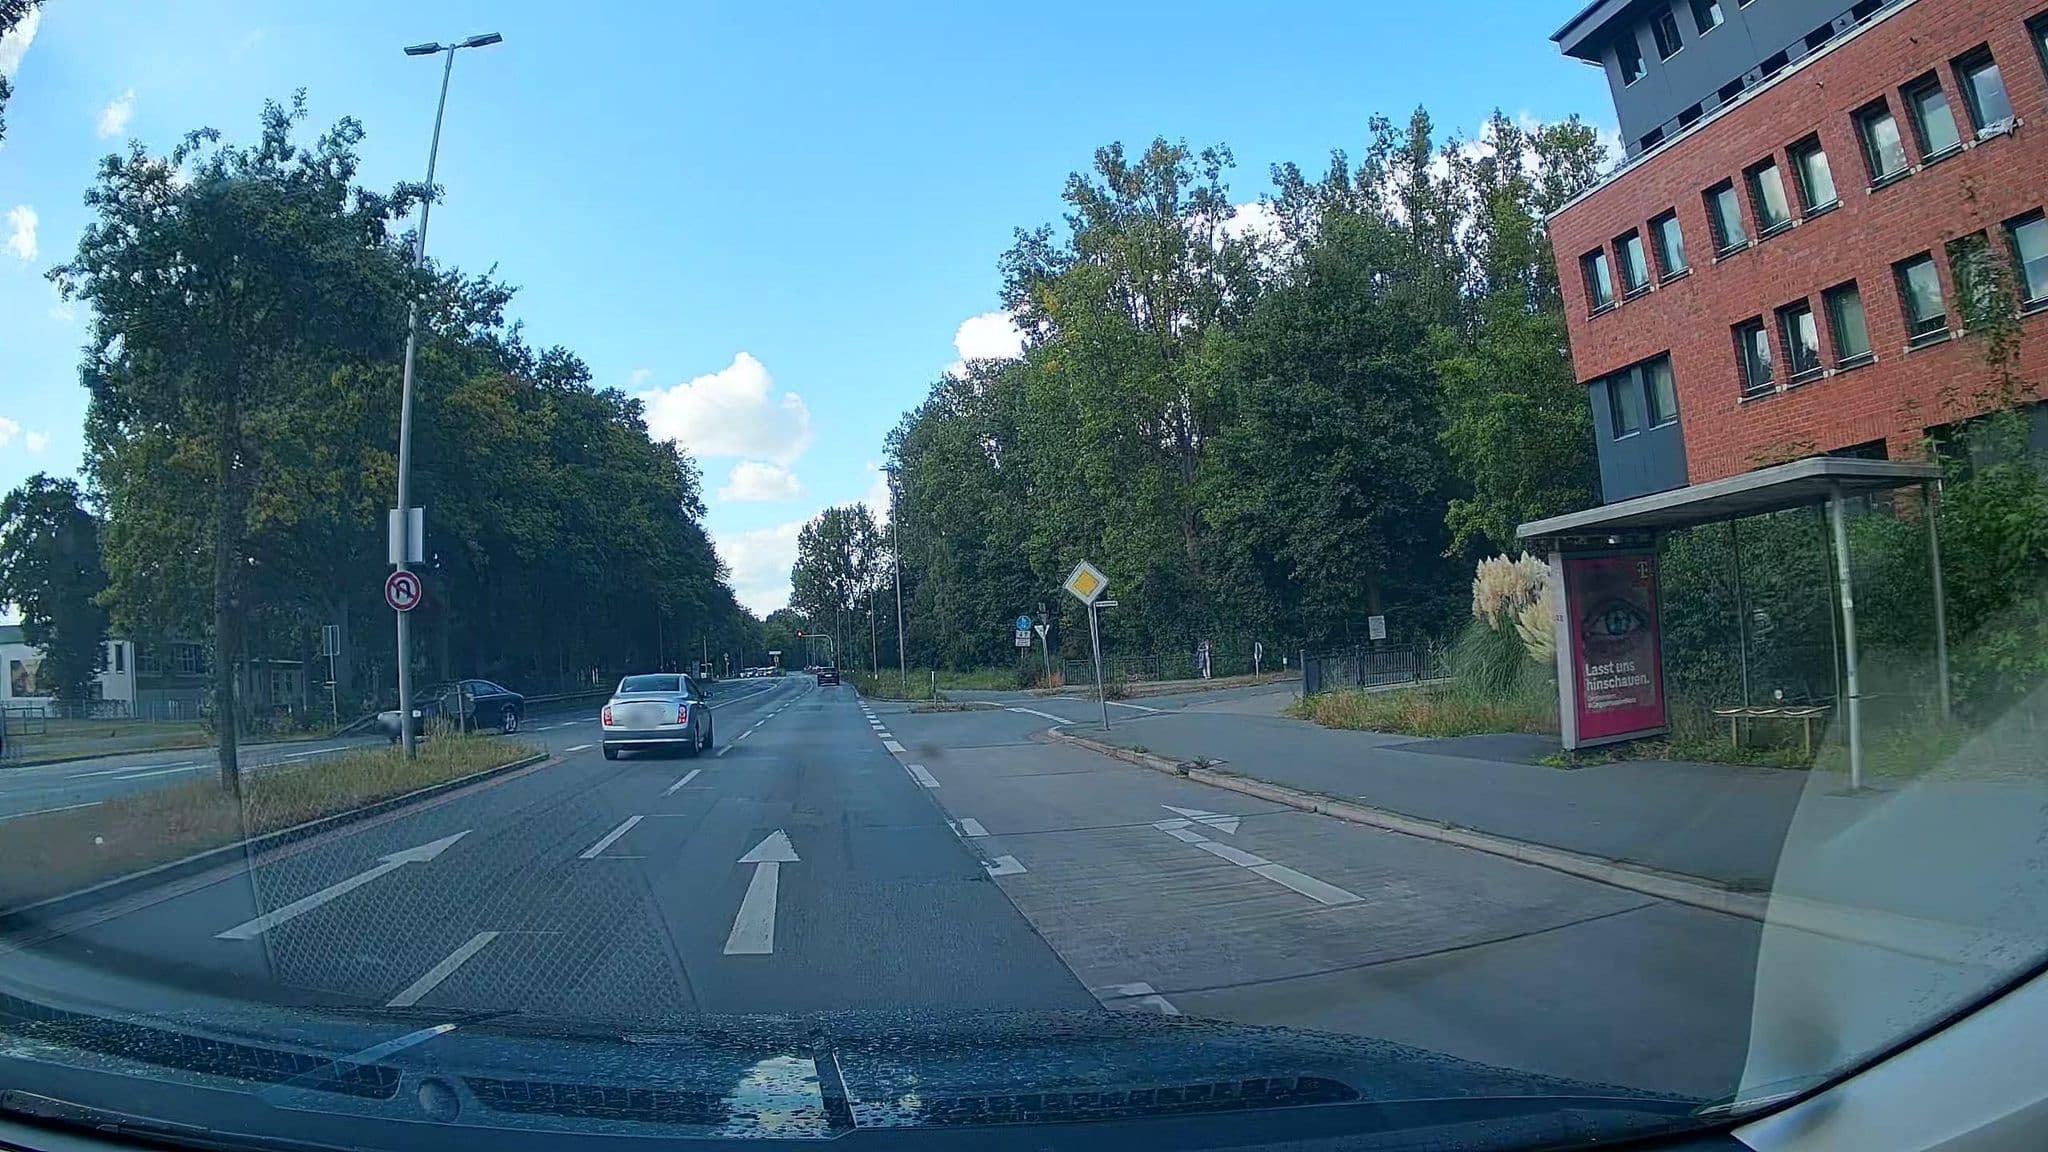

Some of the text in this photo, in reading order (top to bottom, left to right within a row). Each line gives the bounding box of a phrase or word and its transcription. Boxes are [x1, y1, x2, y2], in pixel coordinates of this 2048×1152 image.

[1585, 661, 1635, 677] Lasst uns
[1586, 674, 1650, 691] hinschauen.
